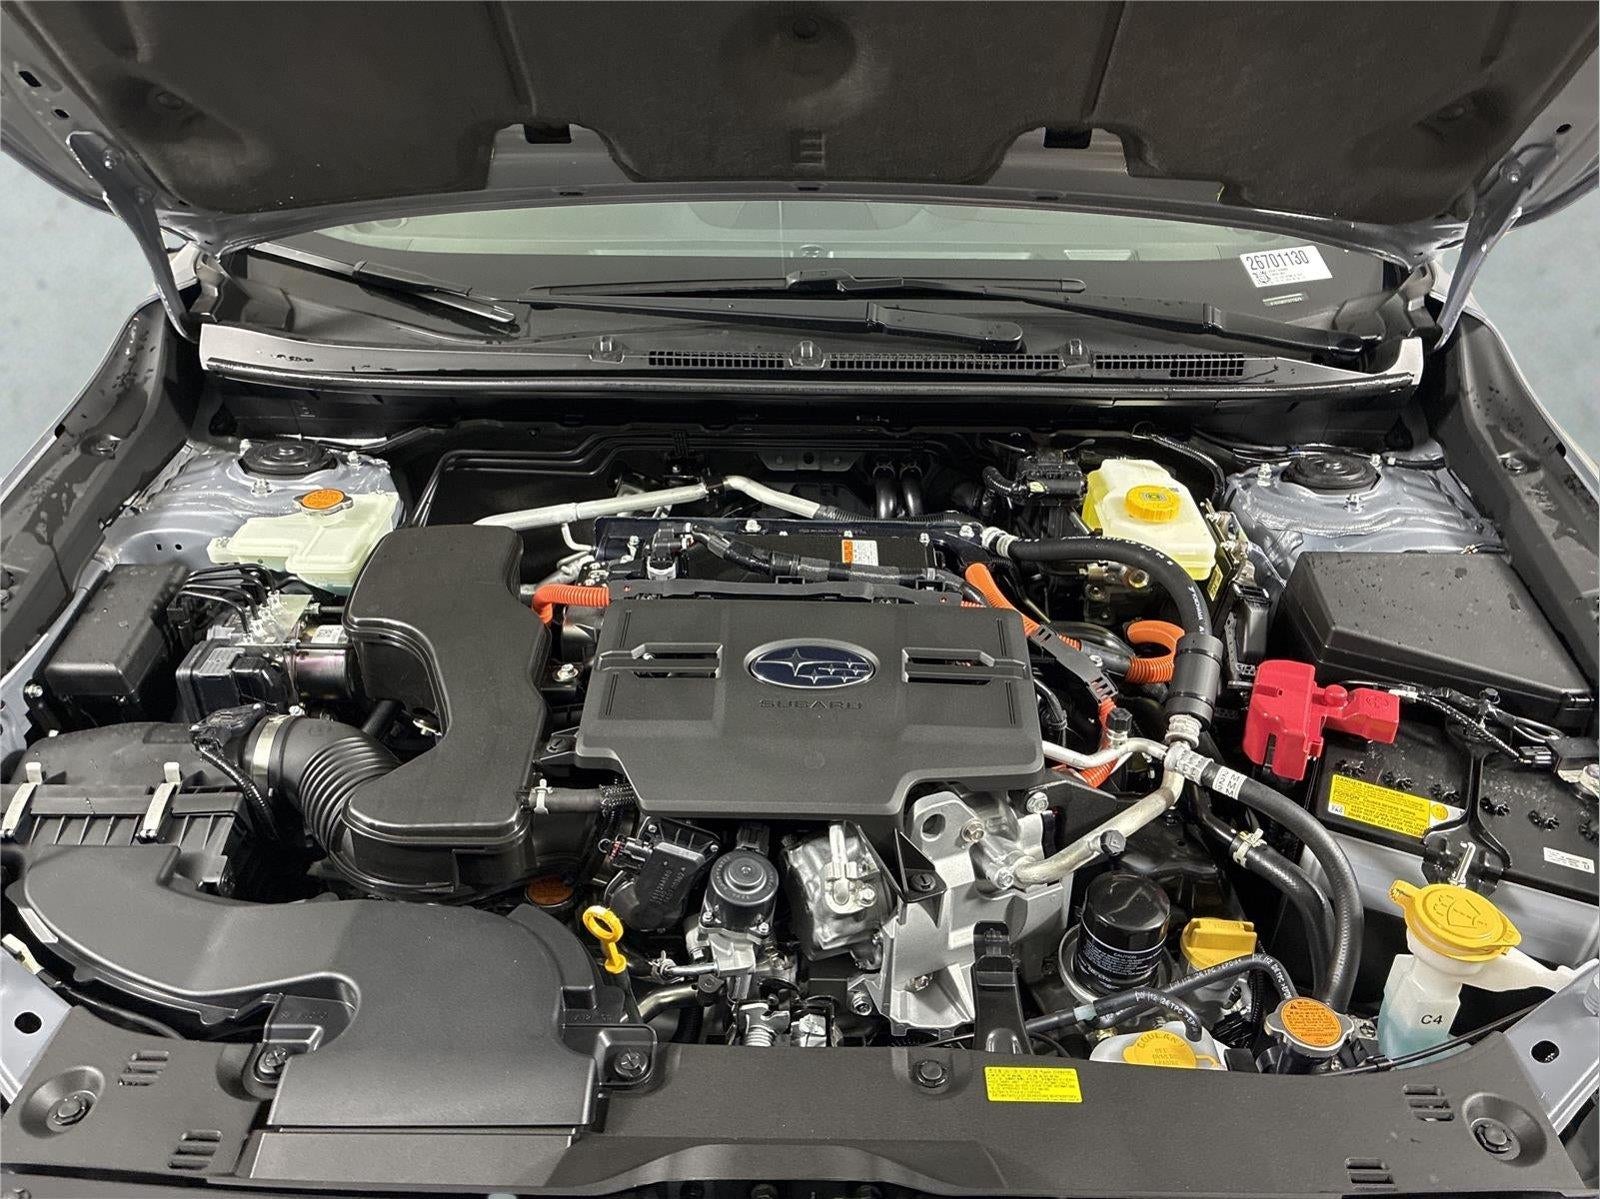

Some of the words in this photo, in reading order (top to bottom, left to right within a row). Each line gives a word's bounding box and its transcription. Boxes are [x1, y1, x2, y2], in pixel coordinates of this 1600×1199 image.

[1246, 249, 1309, 271] 26701130
[759, 699, 863, 710] SUBARU
[1420, 1014, 1443, 1026] C4
